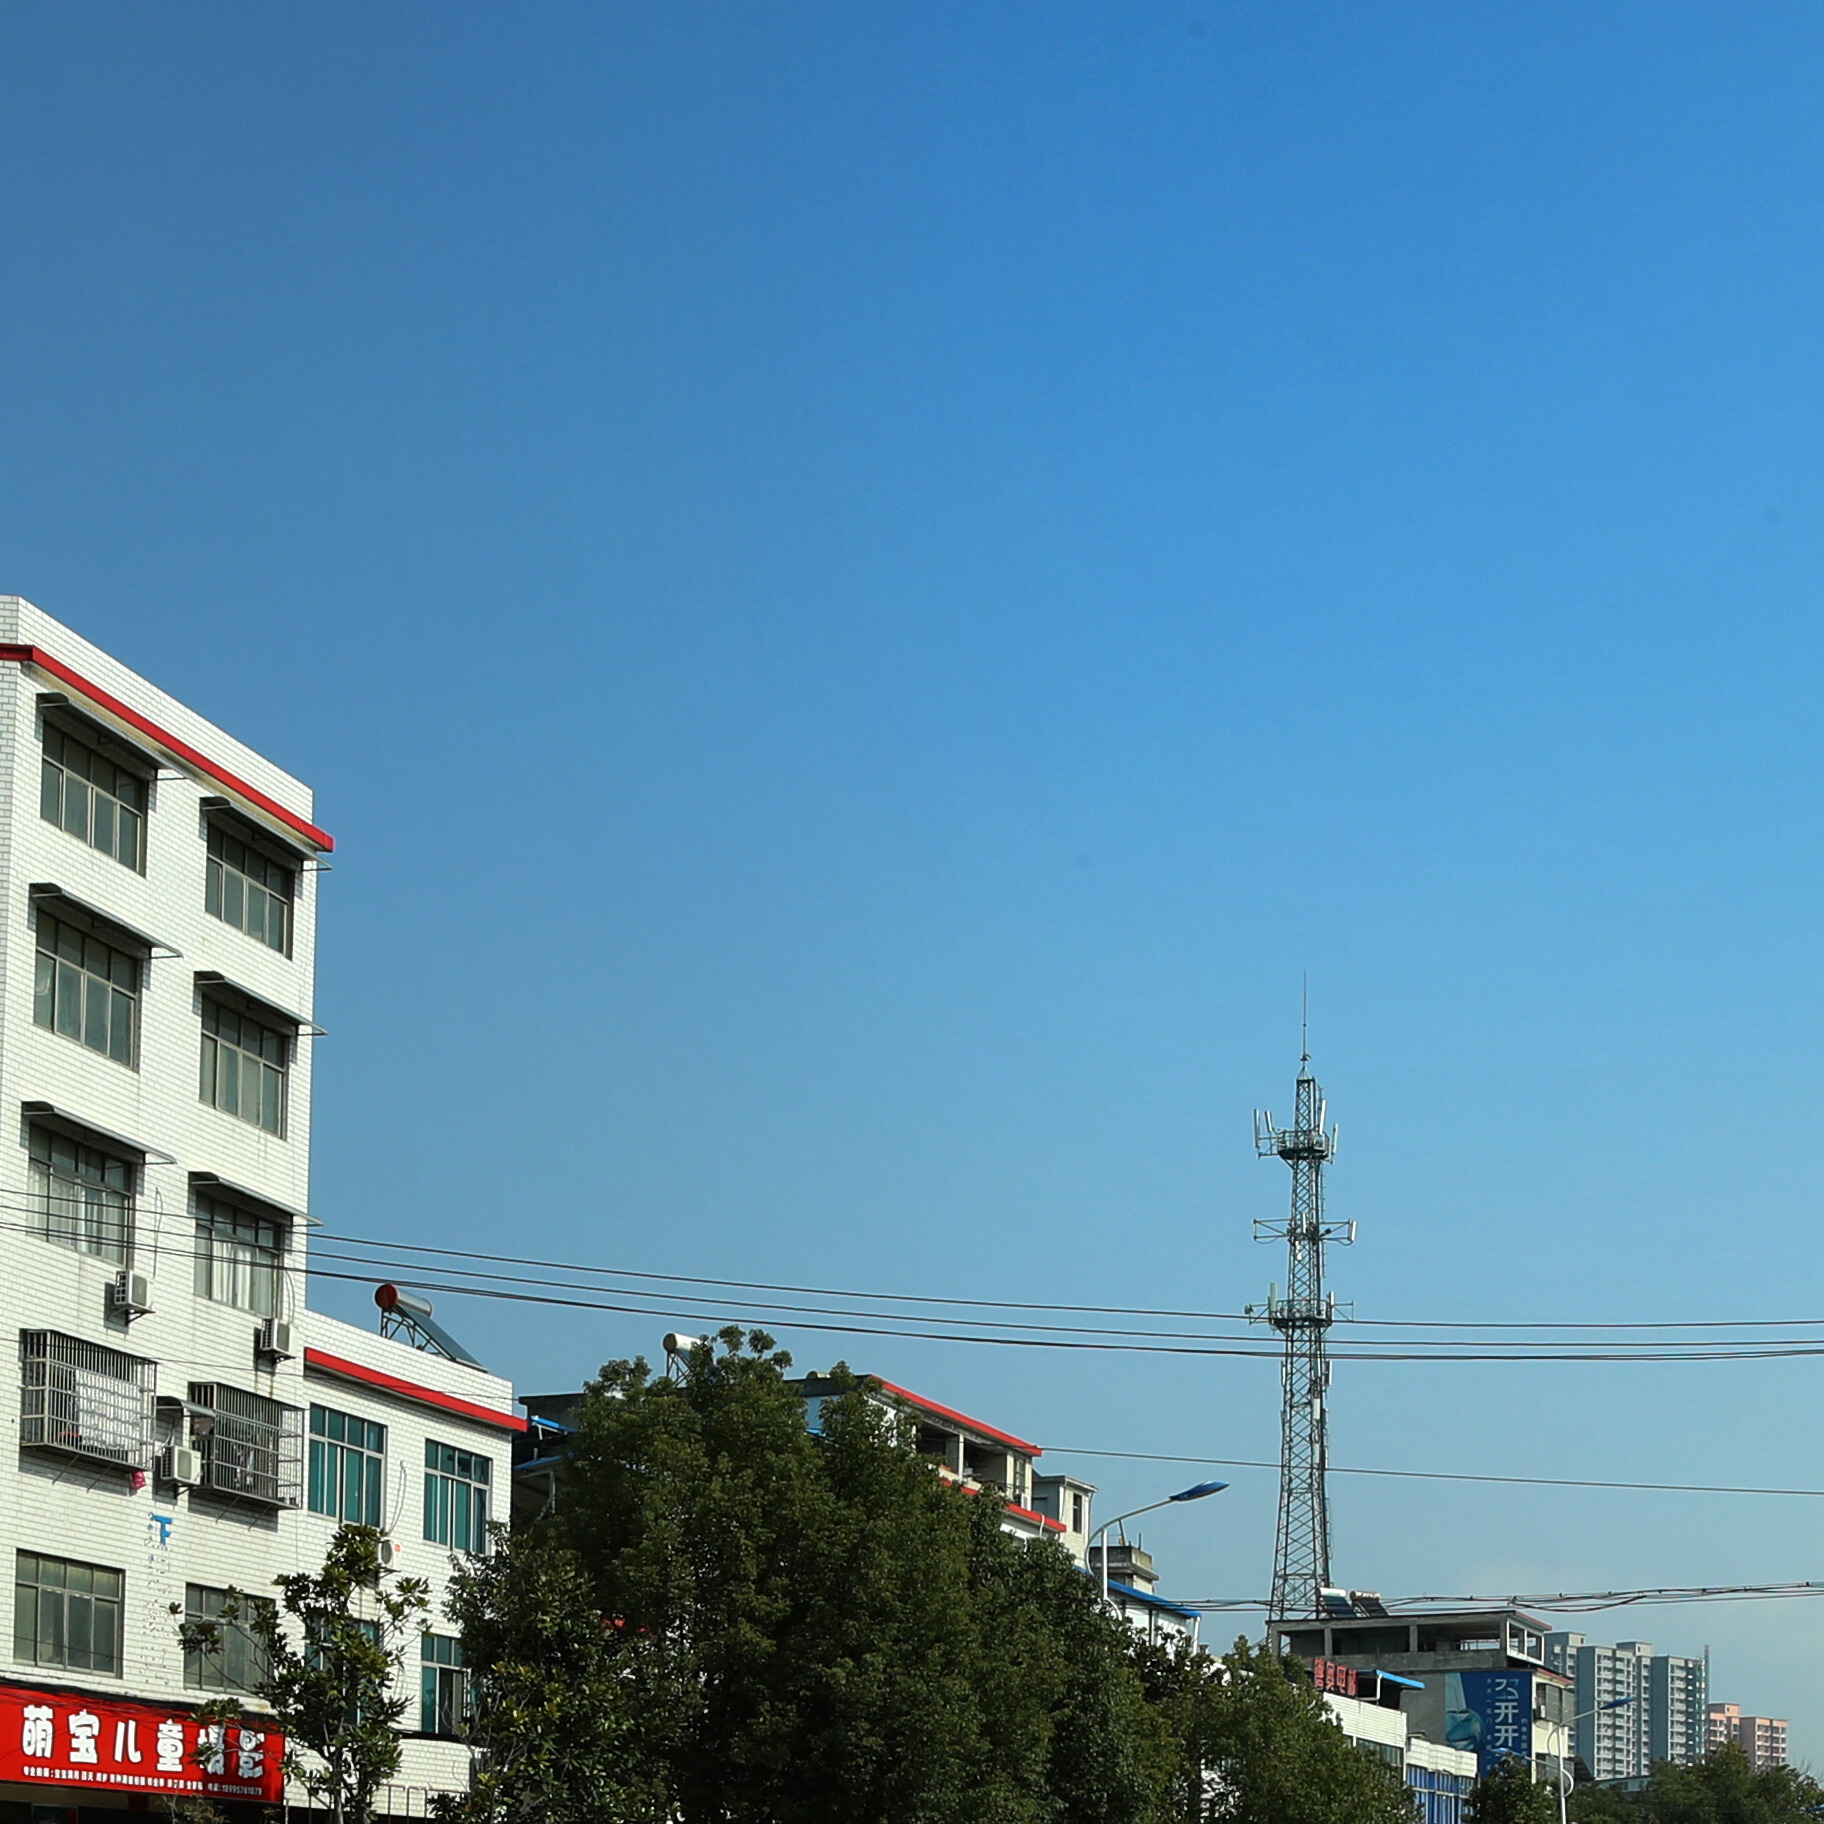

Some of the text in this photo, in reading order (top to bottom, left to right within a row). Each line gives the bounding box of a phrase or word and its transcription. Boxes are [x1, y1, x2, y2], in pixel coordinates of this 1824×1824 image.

[22, 1704, 265, 1779] 萌宝儿童摄影
